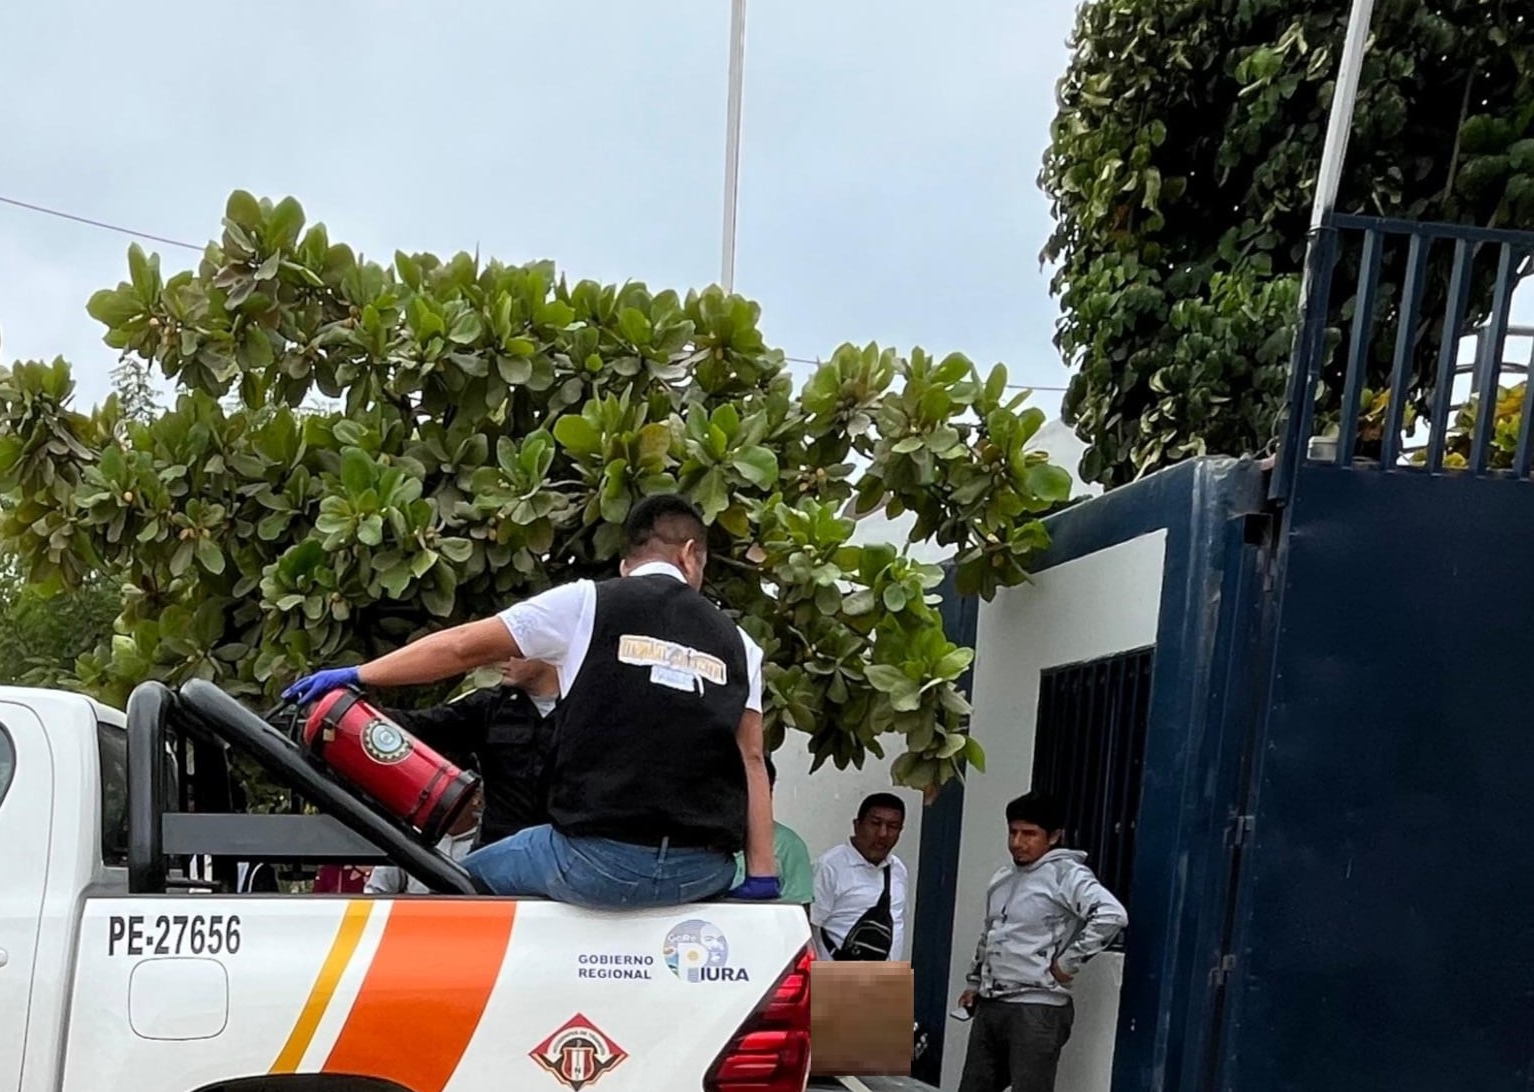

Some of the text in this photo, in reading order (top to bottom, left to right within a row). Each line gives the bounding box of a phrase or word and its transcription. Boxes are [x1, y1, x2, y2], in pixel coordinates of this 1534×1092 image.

[108, 914, 242, 957] PE-27656
[577, 953, 655, 966] GOBIERNO
[577, 967, 654, 980] REGIONAL
